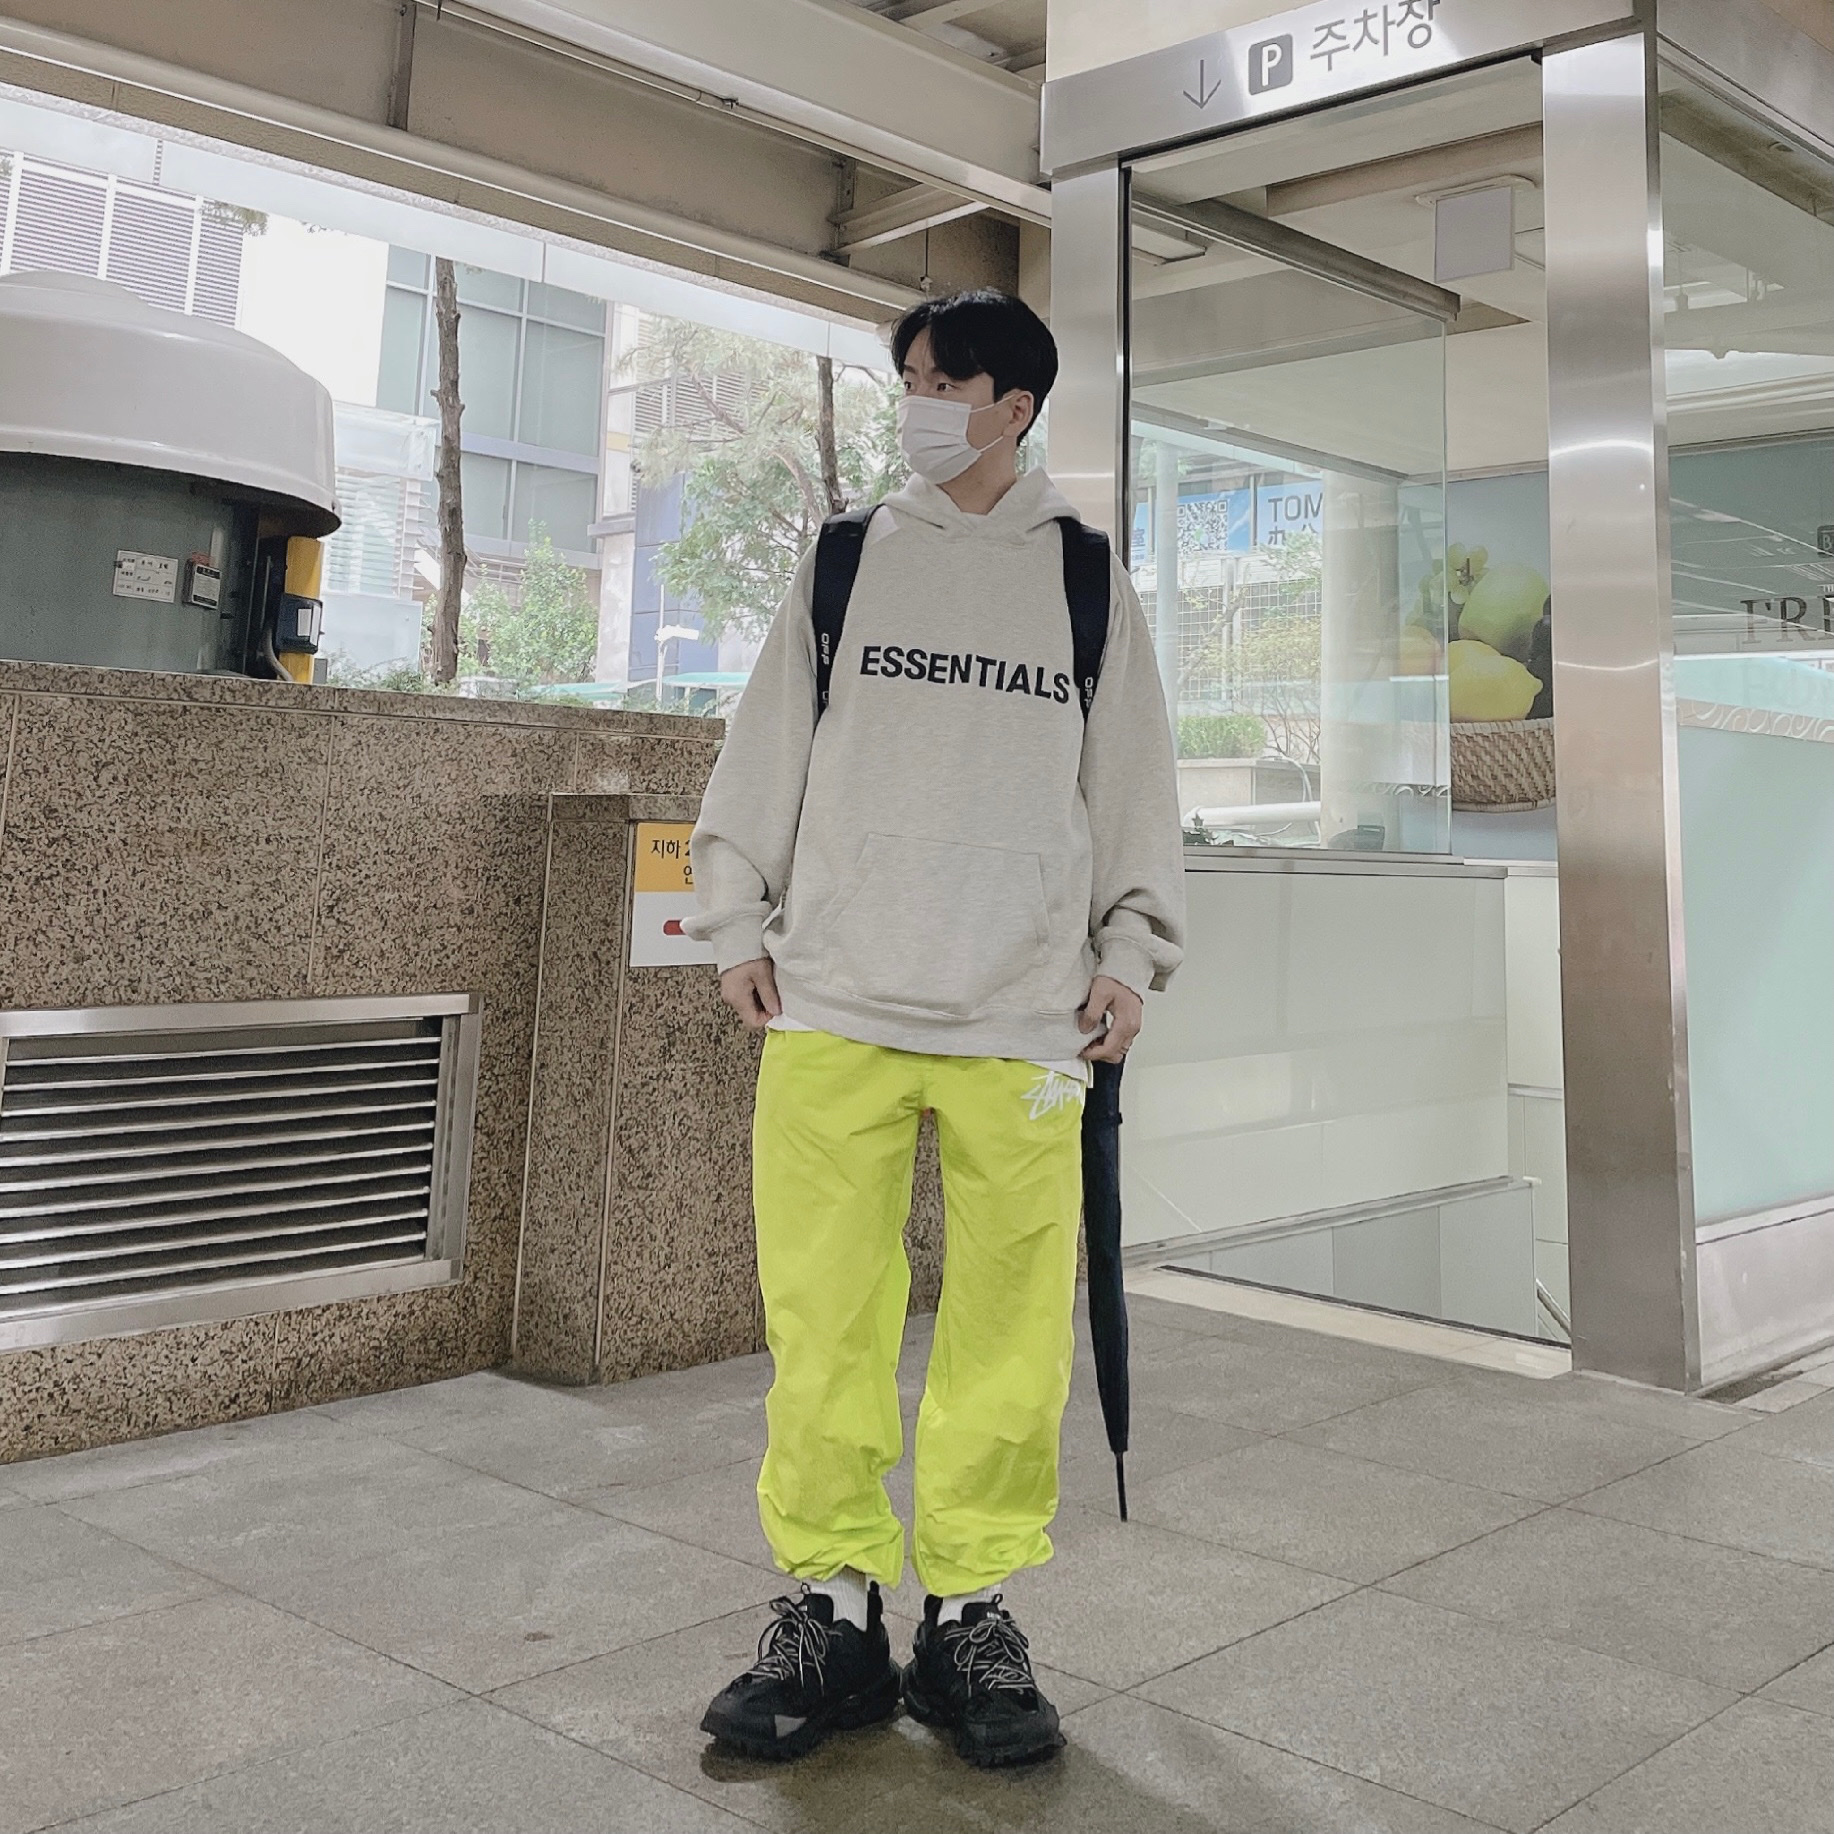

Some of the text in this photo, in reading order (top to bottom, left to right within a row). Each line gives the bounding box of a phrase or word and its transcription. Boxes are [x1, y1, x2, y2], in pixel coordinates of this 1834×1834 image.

[1261, 0, 1440, 87] P 주차장
[860, 646, 1070, 704] ESSENTIALS
[651, 839, 681, 859] 지하
